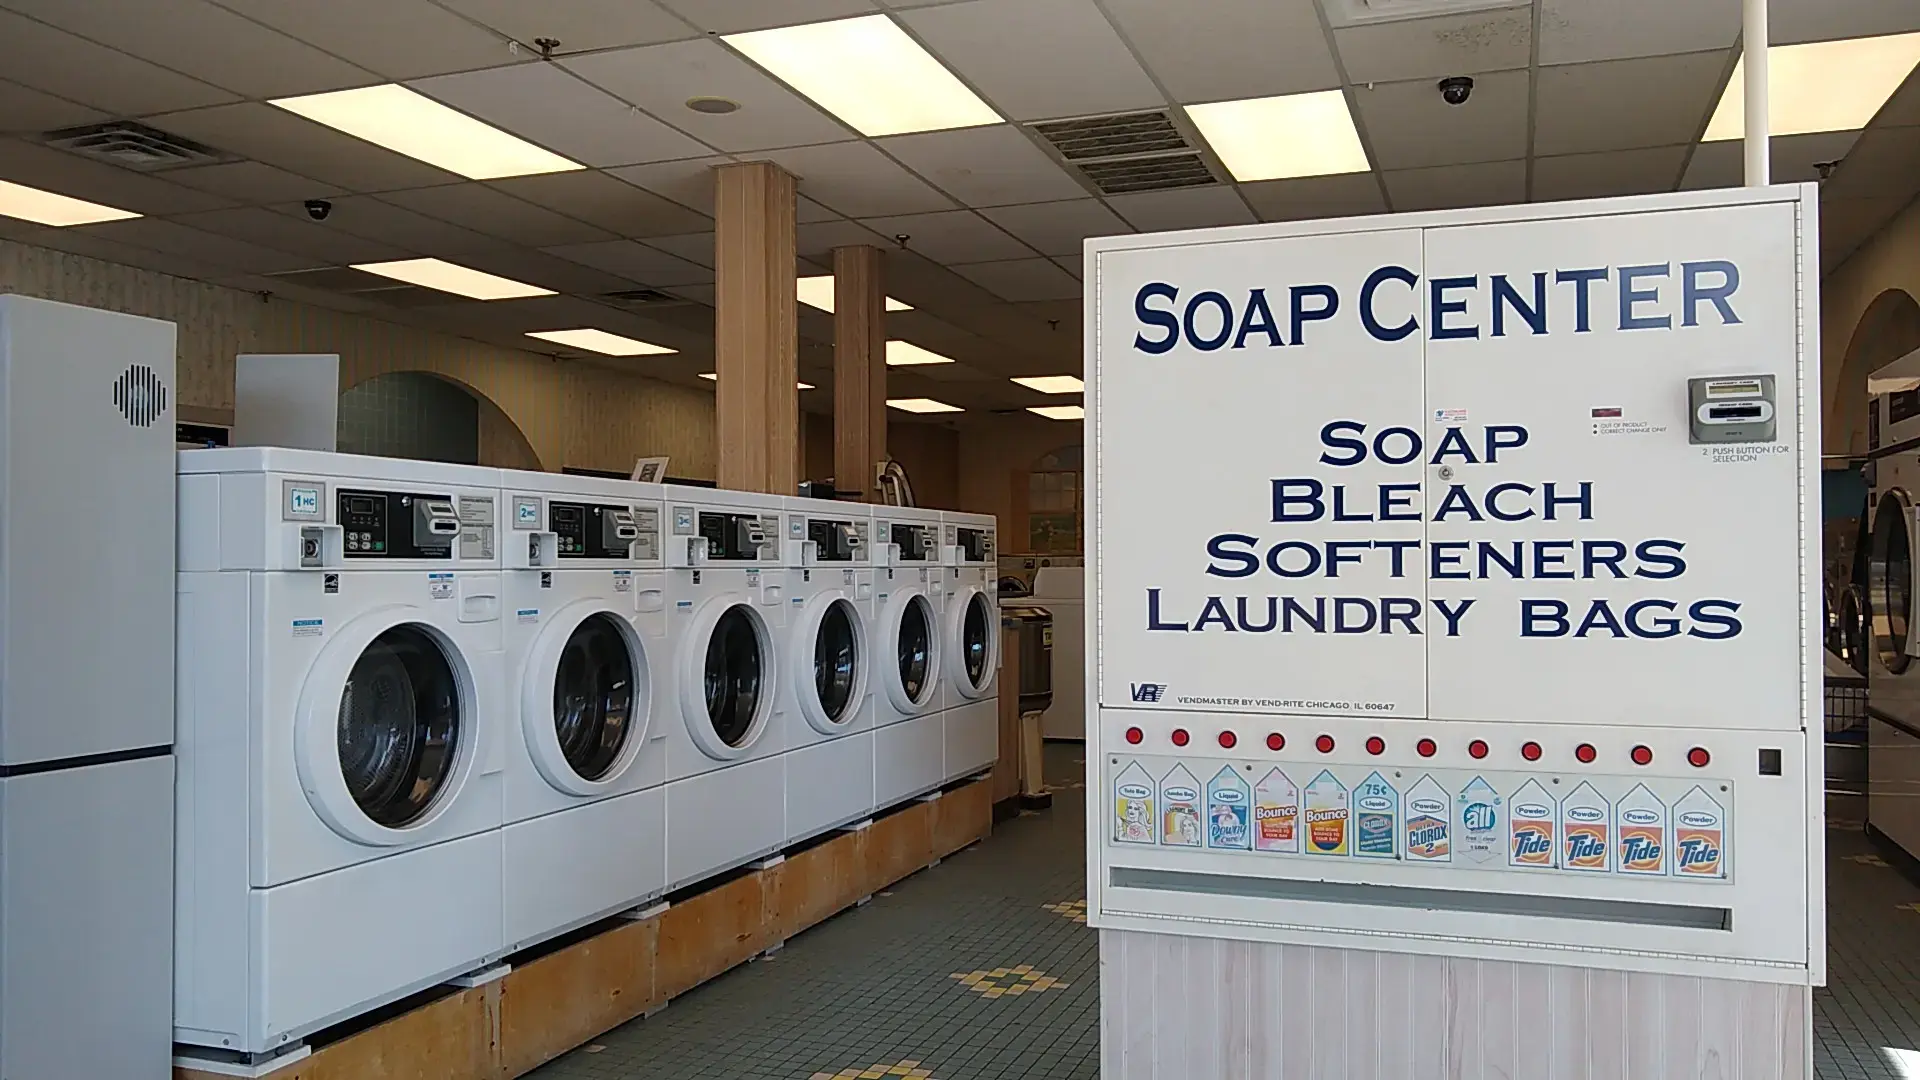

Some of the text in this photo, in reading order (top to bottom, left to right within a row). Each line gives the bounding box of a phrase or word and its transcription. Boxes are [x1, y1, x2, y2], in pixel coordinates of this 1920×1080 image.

[1134, 260, 1743, 354] SOAP CENTER
[1319, 420, 1529, 467] SOAP
[1712, 447, 1734, 455] PUSH
[1736, 446, 1771, 454] BUTTON
[1712, 454, 1758, 463] SELECTION
[295, 495, 301, 507] 1
[1271, 478, 1594, 523] BLEACH
[1205, 533, 1687, 581] SOFTENERS
[1147, 588, 1743, 640] LAUNDRY BAGS
[1177, 696, 1240, 705] VENDMASTER
[1255, 699, 1304, 708] VEND-RITE
[1365, 703, 1395, 711] 60647
[1256, 806, 1297, 819] Bounce
[1306, 808, 1347, 822] Bounce
[1465, 805, 1492, 829] all
[1571, 810, 1600, 818] Powder
[1683, 815, 1713, 823] Powder
[1211, 824, 1247, 840] Downy
[1409, 825, 1447, 847] CLOROX
[1425, 843, 1434, 853] 2
[1514, 830, 1551, 858] Tide
[1567, 834, 1605, 861] Tide
[1622, 837, 1661, 865] Tide
[1679, 840, 1719, 868] Tide
